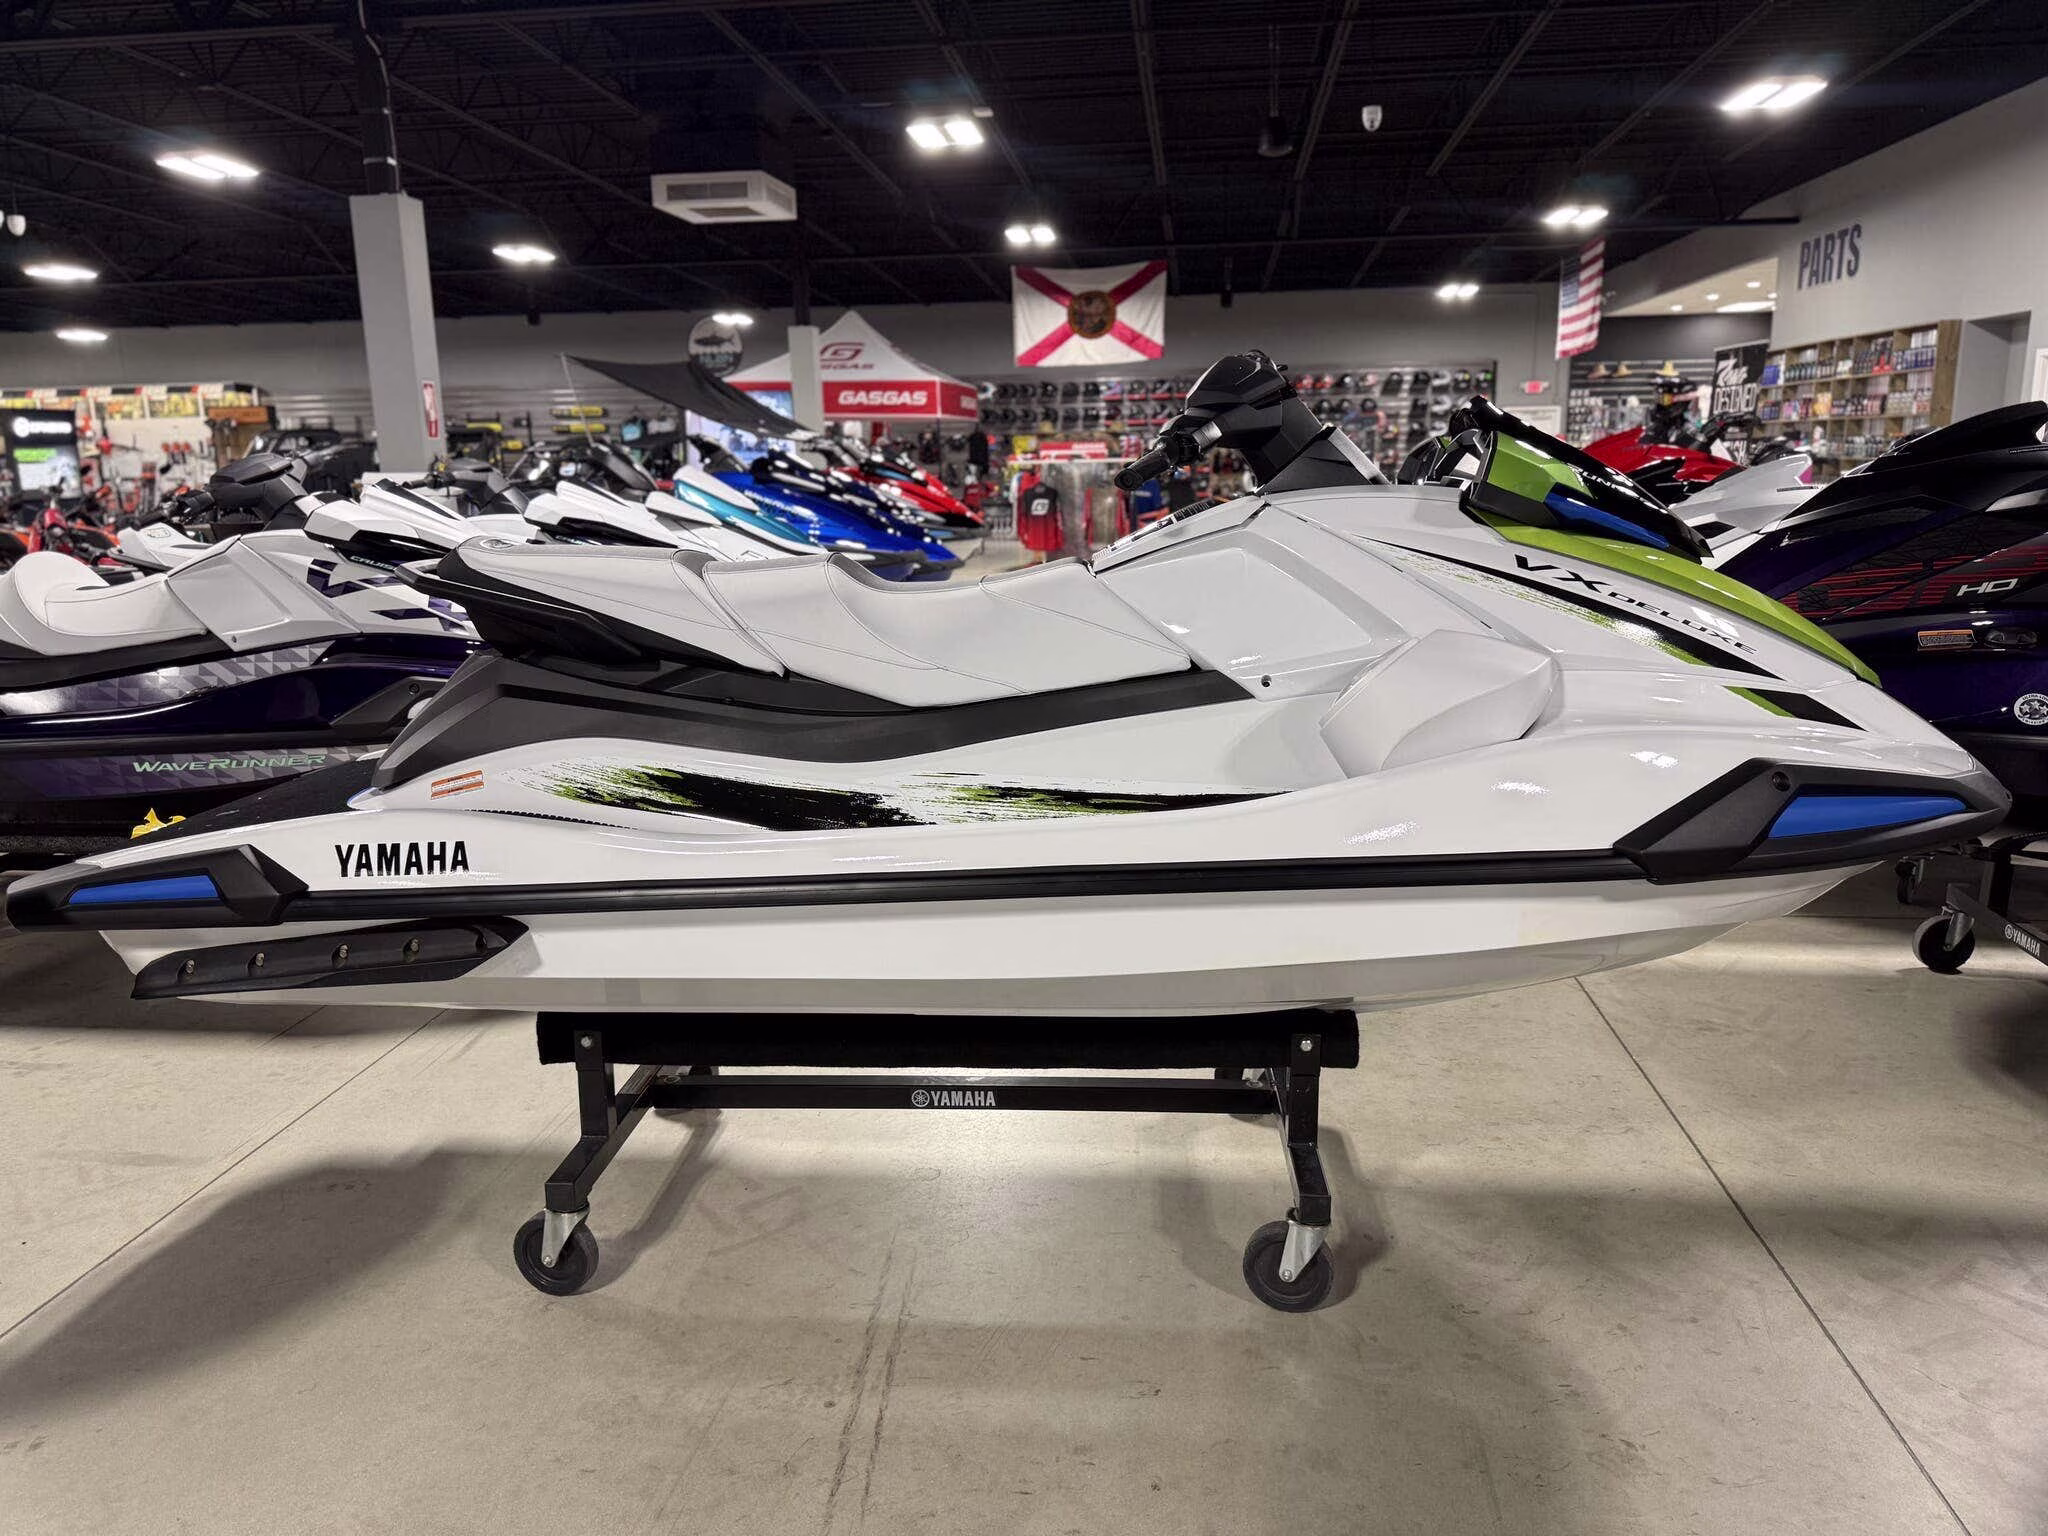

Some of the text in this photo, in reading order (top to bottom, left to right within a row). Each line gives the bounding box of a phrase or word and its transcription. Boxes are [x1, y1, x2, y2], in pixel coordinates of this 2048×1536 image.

[1798, 223, 1862, 291] PARTS
[838, 390, 928, 406] GASGAS
[1514, 554, 1758, 655] VX DELUXE
[335, 840, 470, 878] YAMAHA
[2013, 928, 2041, 957] YAMAHA
[930, 1090, 996, 1107] YAMAHA
